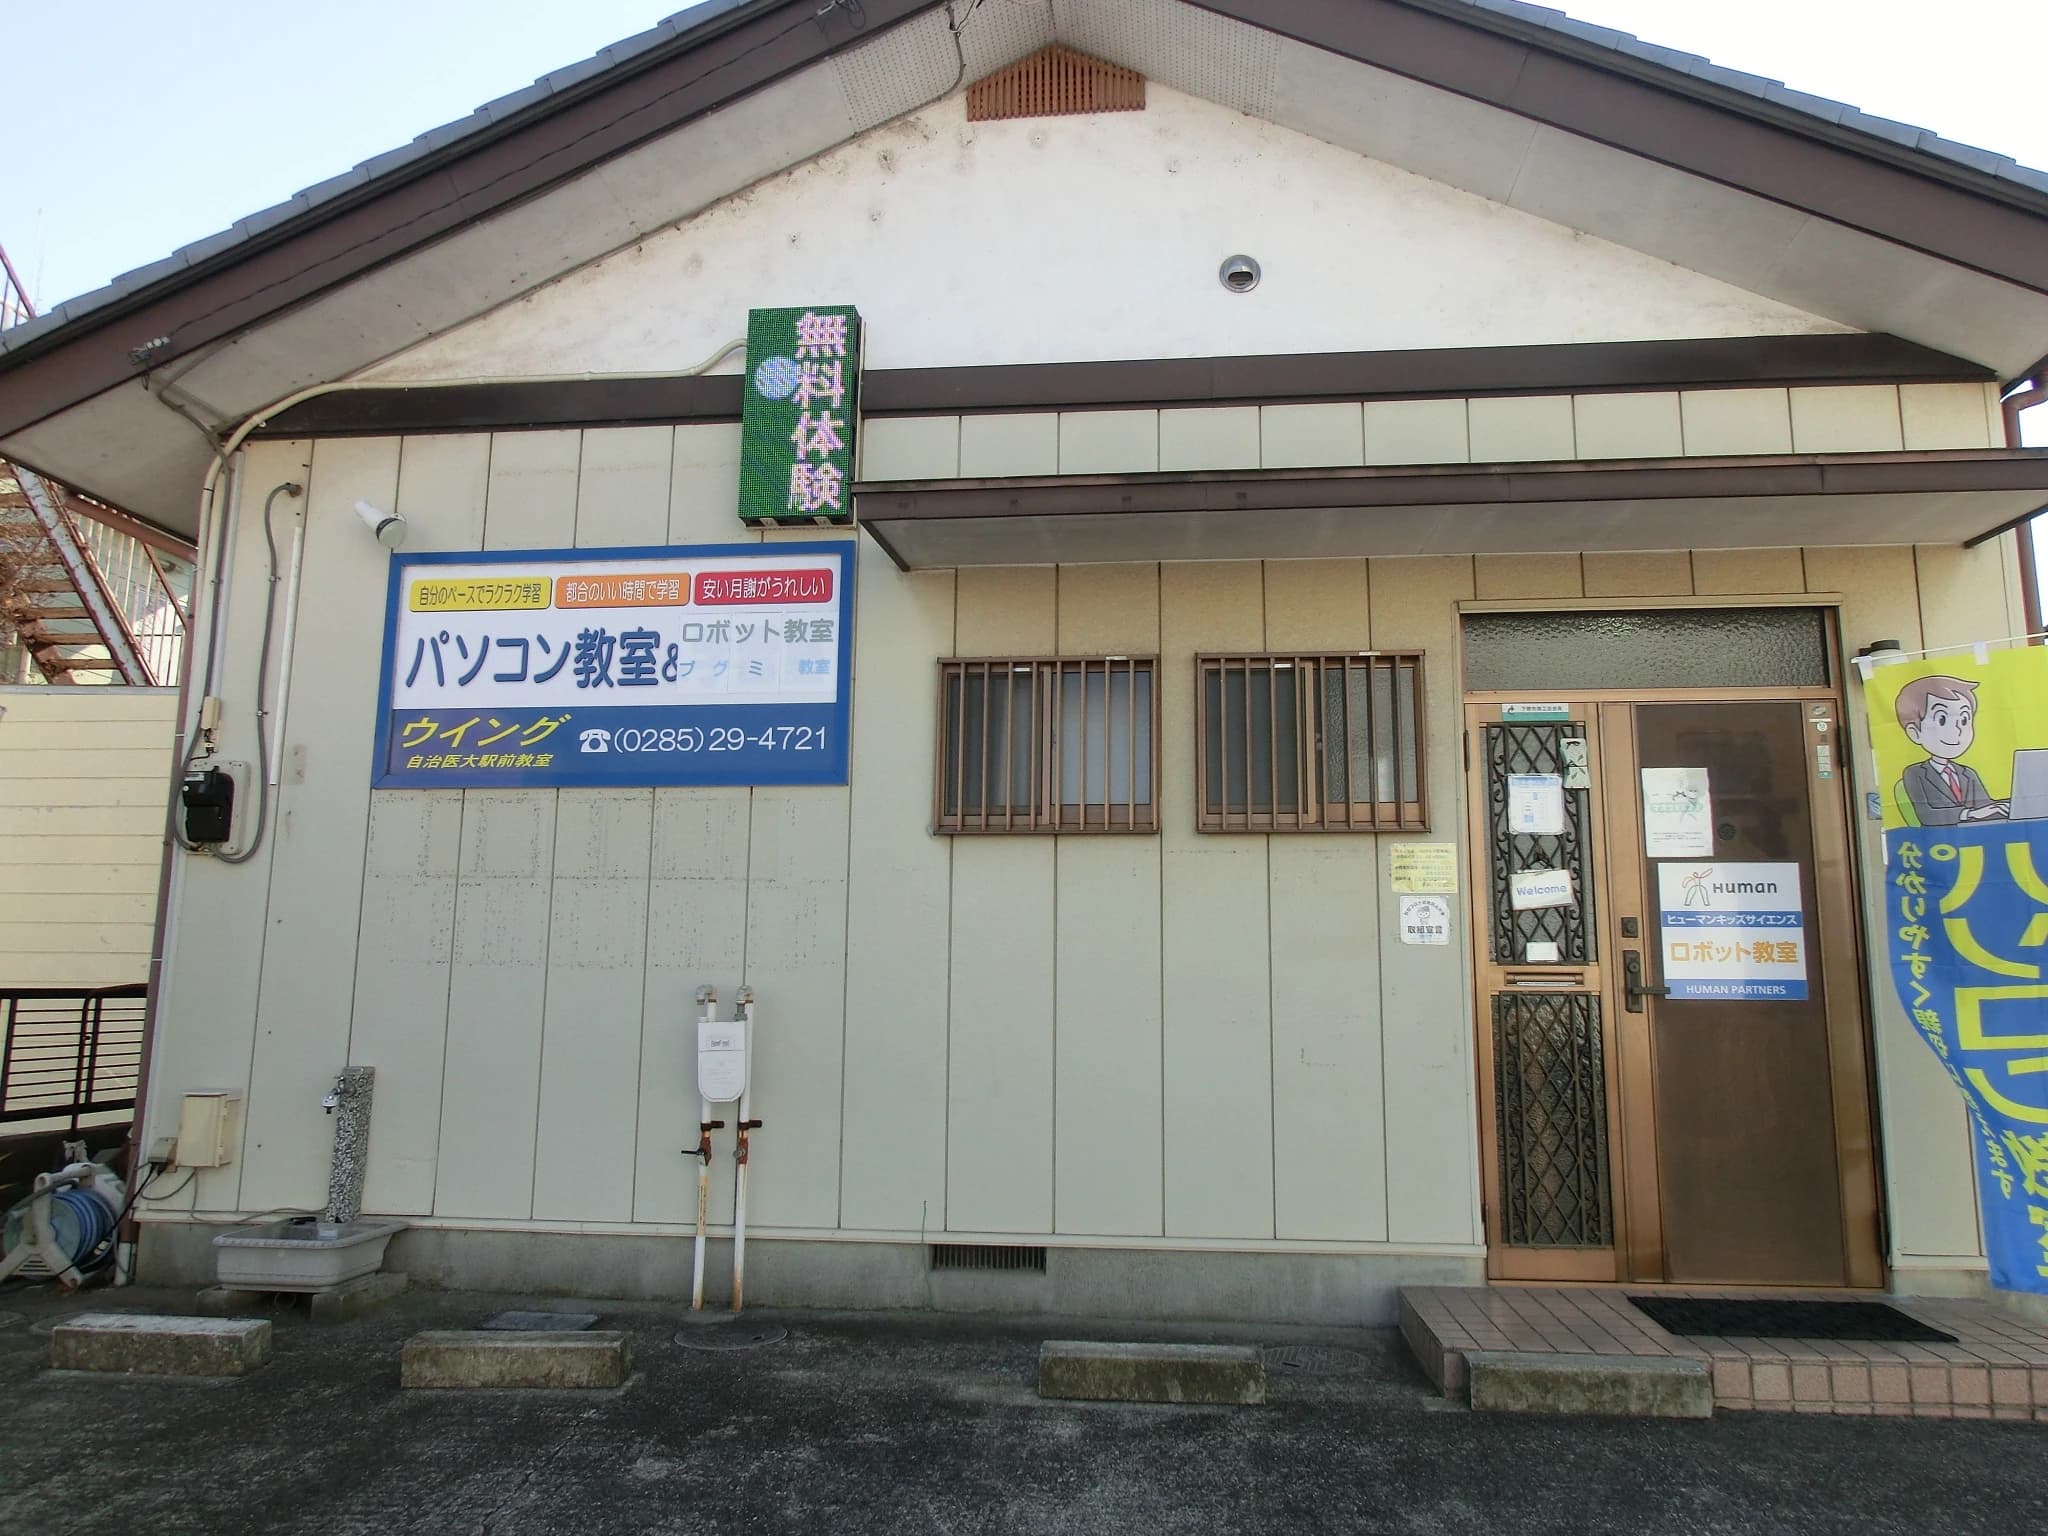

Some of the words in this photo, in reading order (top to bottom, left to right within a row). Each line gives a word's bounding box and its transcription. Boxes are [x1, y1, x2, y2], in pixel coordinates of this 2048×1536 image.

[787, 312, 848, 512] 無料体験
[419, 583, 542, 606] 自分のペースでラクラク学習
[566, 578, 680, 602] 都合のいい時間で学習
[702, 574, 826, 600] 安い月謝がうれしい
[682, 618, 834, 644] ロボット教室
[402, 713, 571, 749] ウイング
[406, 753, 554, 769] 自治医大駅前教室
[1516, 884, 1567, 896] Welcome
[1713, 880, 1777, 894] Human
[1667, 913, 1798, 926] ヒューマンキッズサイエンス
[1671, 941, 1799, 963] ロボット教室
[1686, 984, 1728, 995] HUMAN
[1731, 984, 1786, 995] PARTNERS
